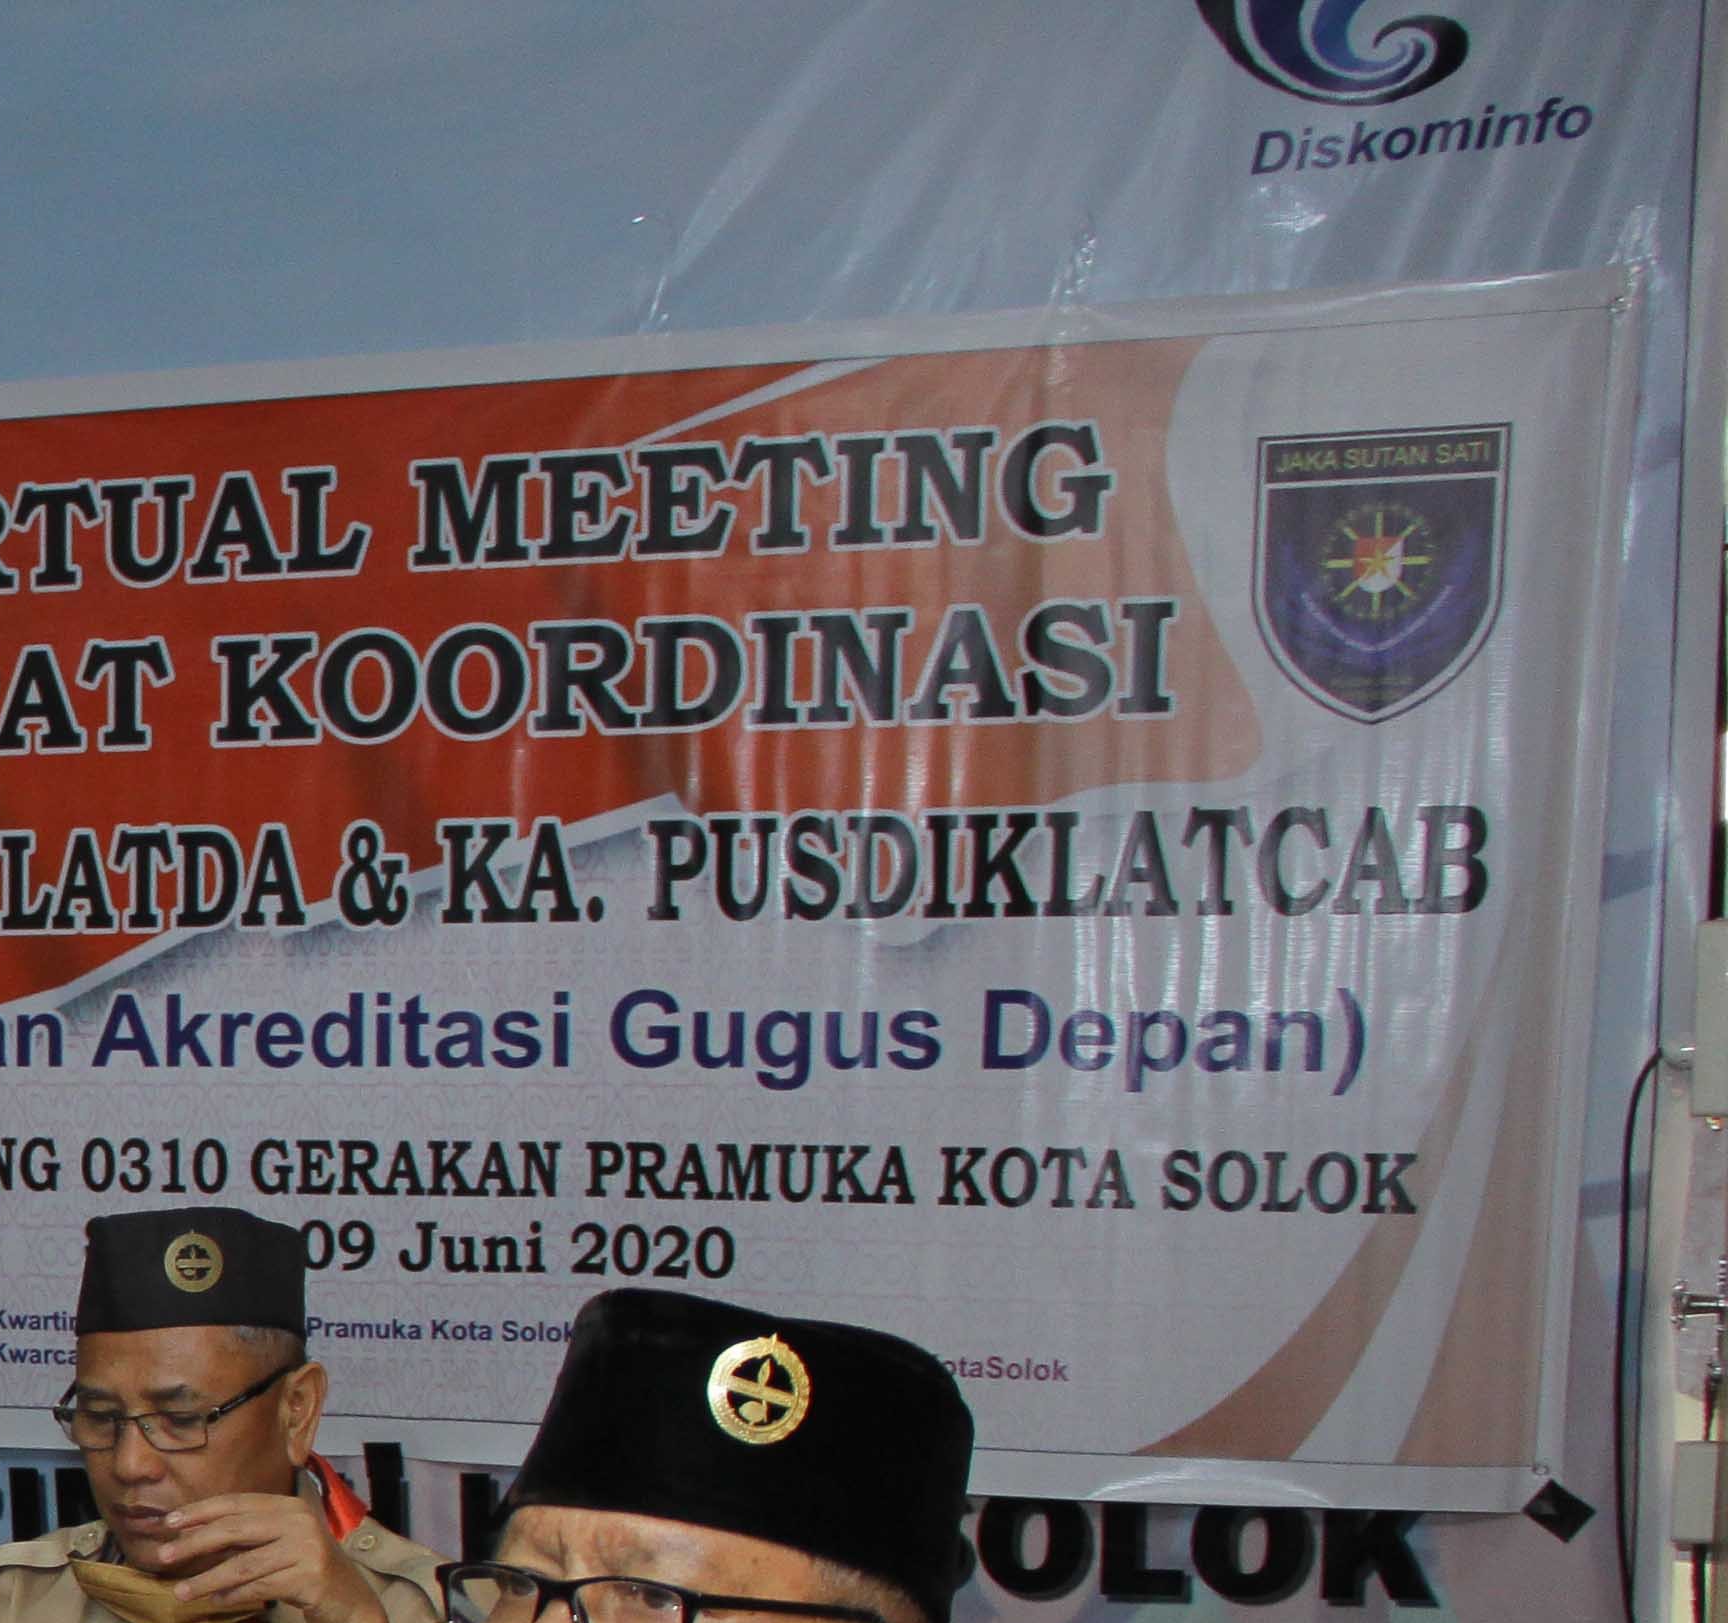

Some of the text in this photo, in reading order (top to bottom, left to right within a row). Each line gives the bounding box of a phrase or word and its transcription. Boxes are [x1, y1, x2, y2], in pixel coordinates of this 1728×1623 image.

[1251, 97, 1593, 176] Diskominfo
[410, 419, 1114, 572] MEETING
[1276, 440, 1491, 474] JAKA SUTAN SATI
[210, 598, 1178, 747] KOORDINASI
[338, 819, 410, 930] &
[440, 816, 606, 926] KA.
[647, 804, 1489, 922] PUSDIKLATCAB
[93, 990, 571, 1070] Akreditasi
[610, 988, 941, 1091] Gugus
[981, 986, 1367, 1096] Depan)
[81, 1137, 229, 1195] 0310
[250, 1138, 562, 1199] GERAKAN
[585, 1141, 915, 1206] PRAMUKA
[937, 1146, 1136, 1211] KOTA
[1160, 1149, 1419, 1216] SOLOK
[303, 1218, 736, 1280] 09 Juni 2020
[305, 1316, 422, 1341] Pramuka
[431, 1319, 493, 1342] Kota
[501, 1320, 576, 1343] Solok
[935, 1355, 1071, 1382] otaSolok
[959, 1493, 1441, 1608] OLOK
